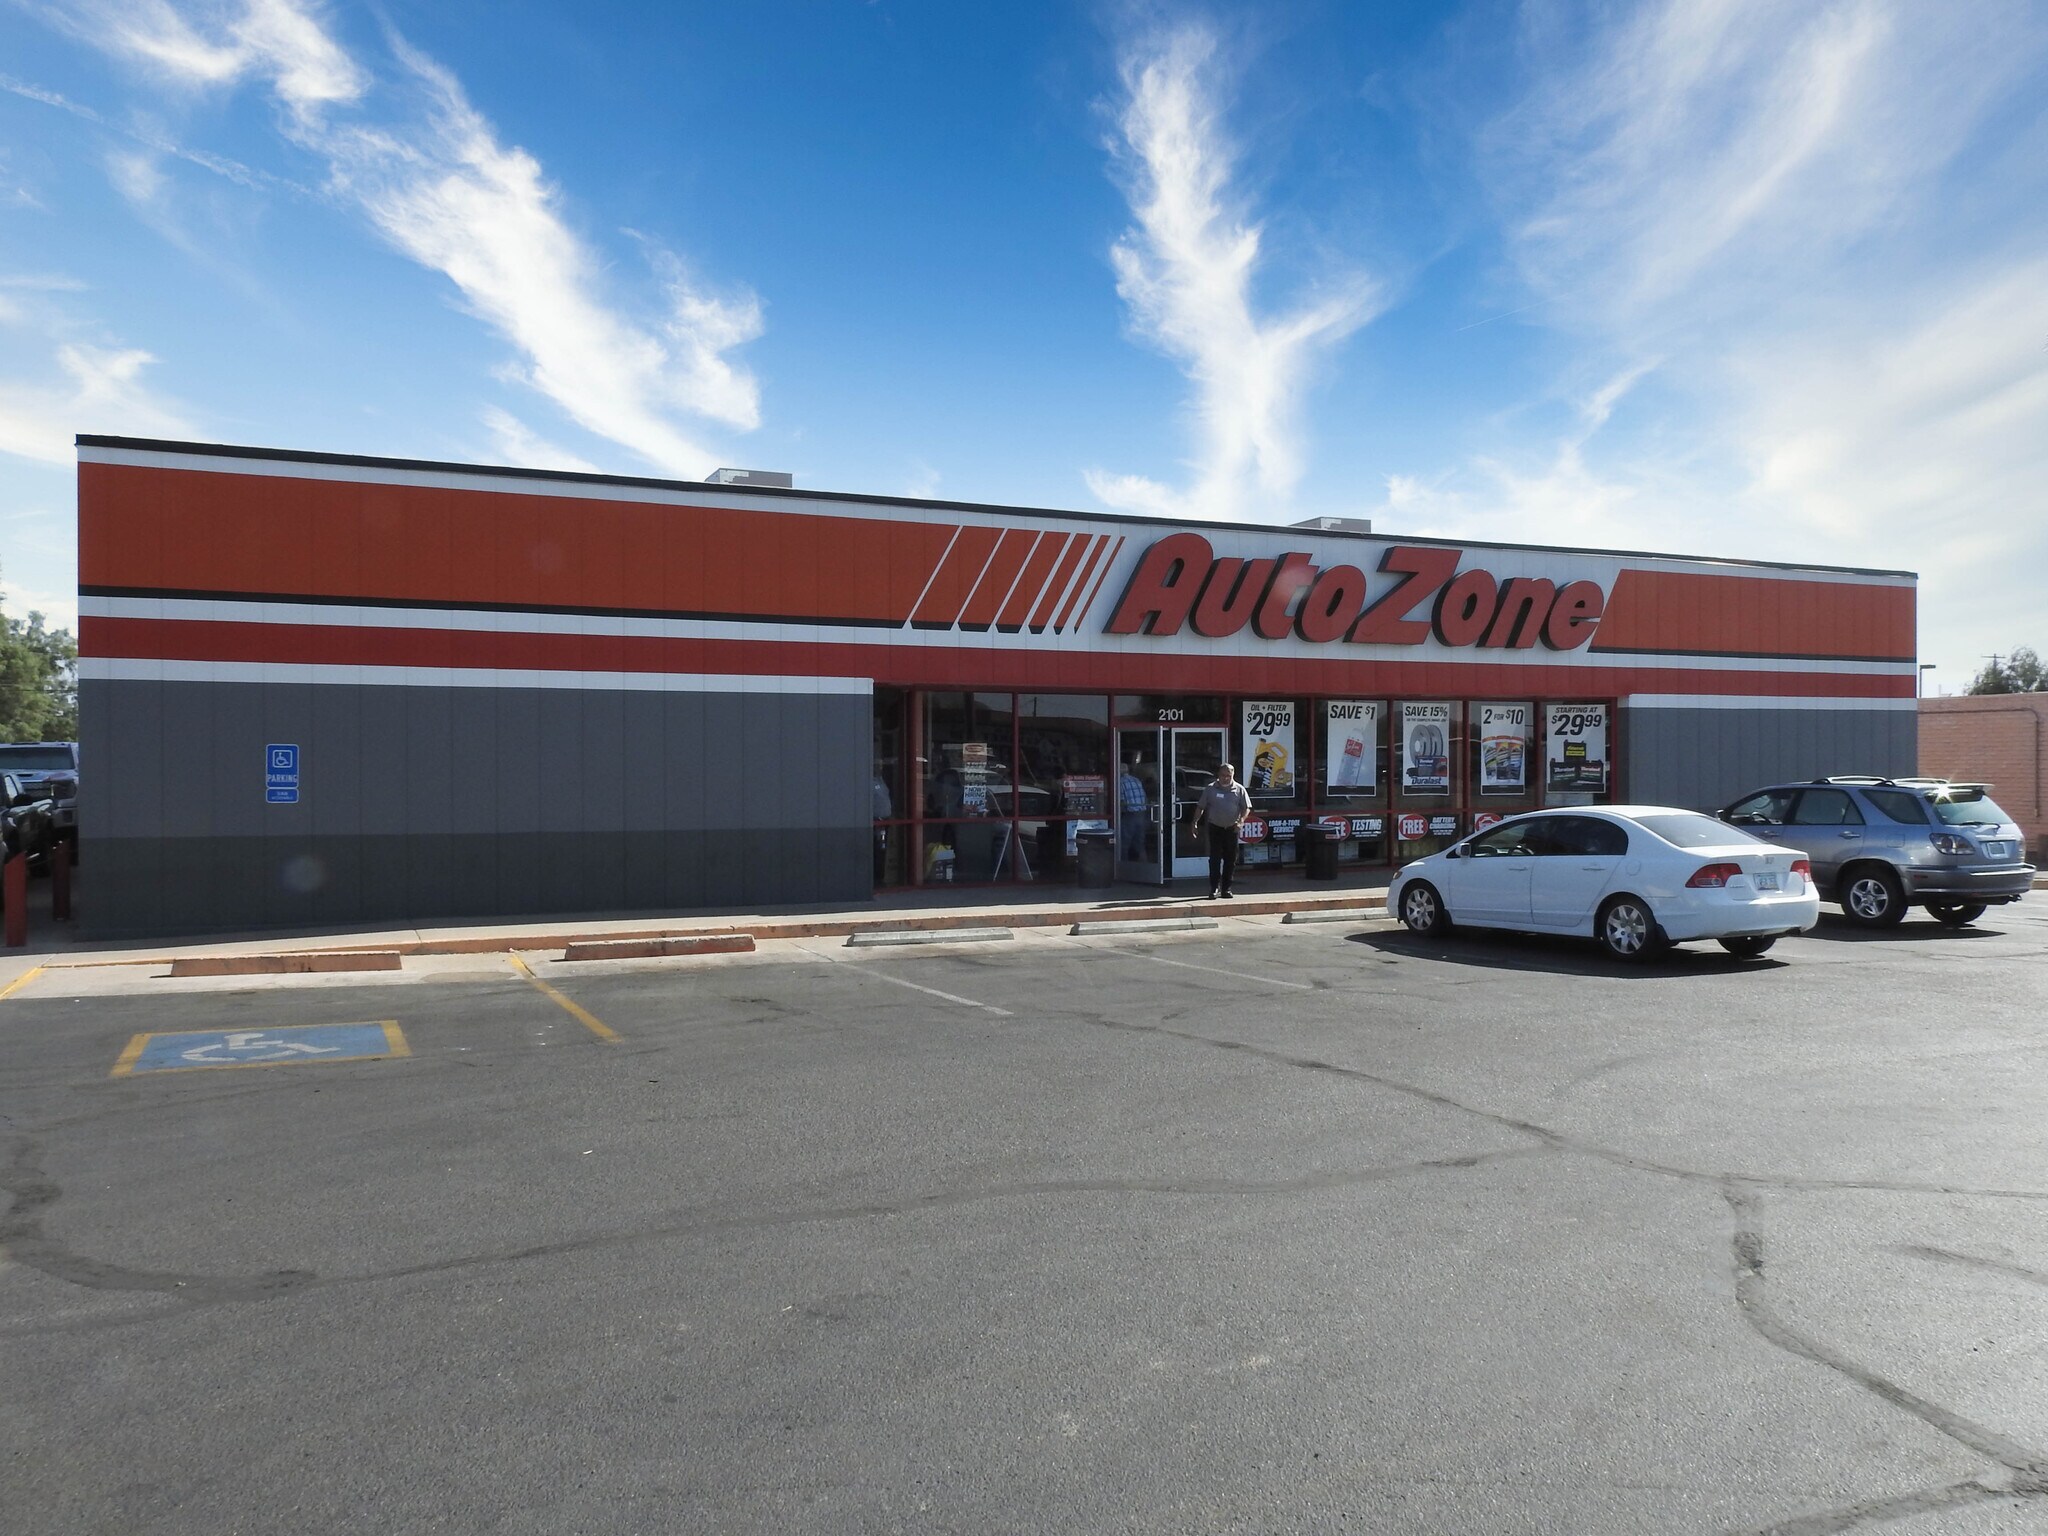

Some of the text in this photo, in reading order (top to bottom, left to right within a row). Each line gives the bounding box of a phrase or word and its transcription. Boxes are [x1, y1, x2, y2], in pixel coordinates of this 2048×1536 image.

[1102, 532, 1605, 652] AutoZone
[1158, 708, 1184, 721] 2101
[1330, 704, 1376, 720] SAVE $1
[1404, 705, 1448, 717] SAVE 15%
[1483, 708, 1493, 724] 2
[1506, 709, 1524, 724] $10
[267, 774, 298, 783] PARKING
[1240, 821, 1263, 838] FREE
[1352, 819, 1382, 831] TESTING
[1402, 819, 1424, 835] FREE
